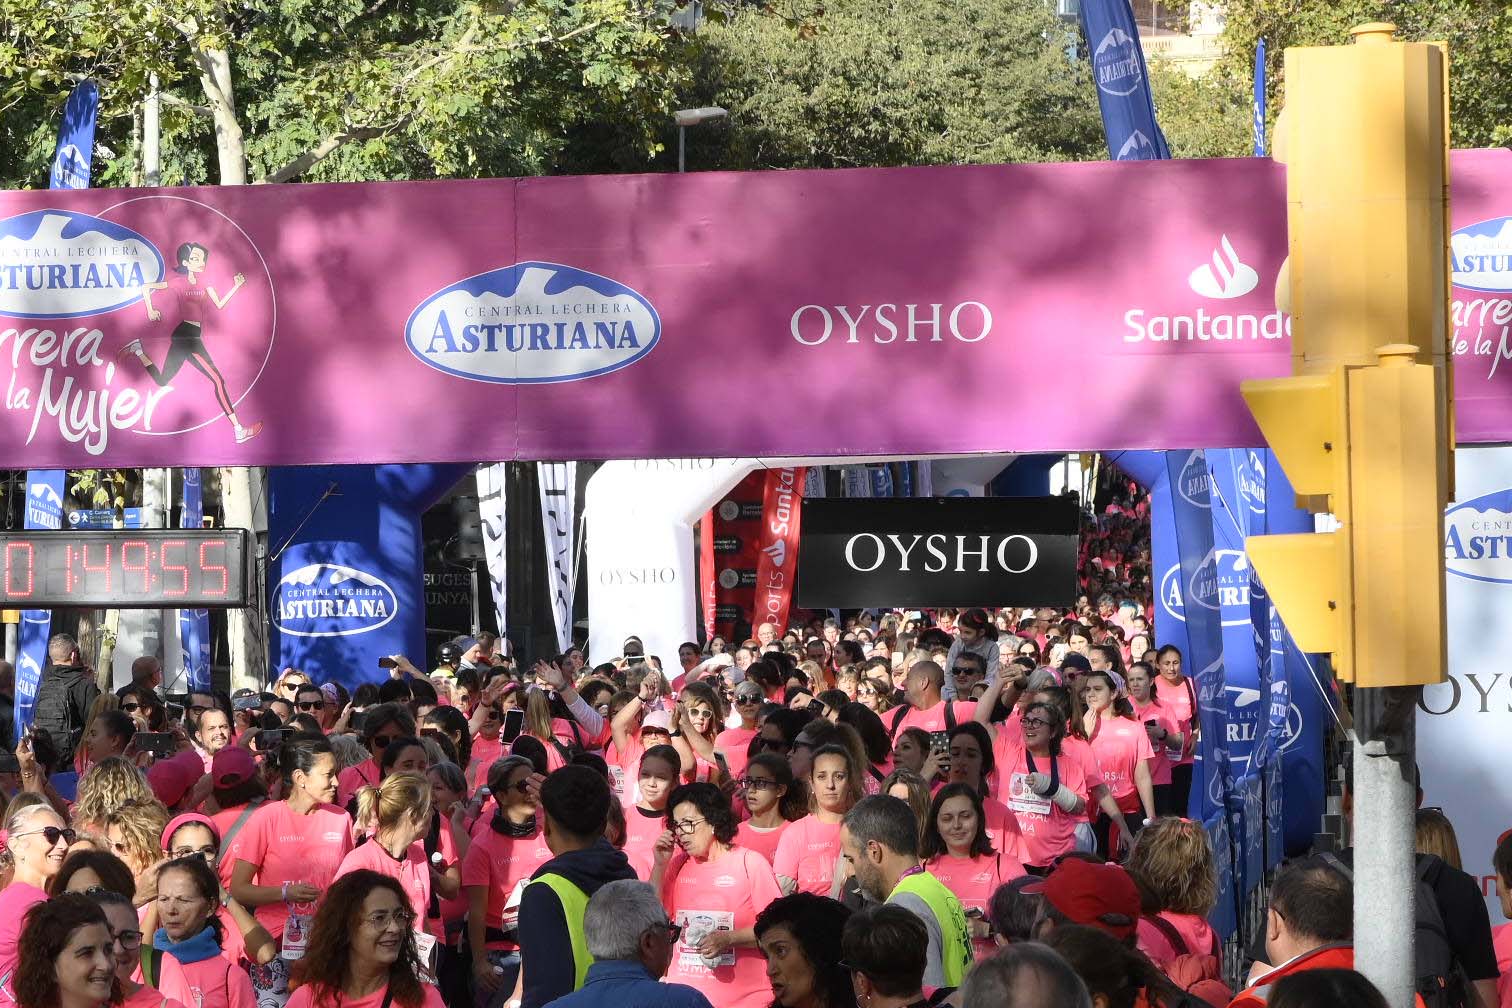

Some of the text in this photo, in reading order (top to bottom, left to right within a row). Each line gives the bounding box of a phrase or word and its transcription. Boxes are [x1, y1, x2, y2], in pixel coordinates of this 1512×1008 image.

[68, 245, 140, 257] LECHERA
[464, 302, 633, 319] CENTRAL LECHERA
[790, 301, 993, 346] OYSHO
[425, 309, 641, 354] ASTURIANA
[1475, 328, 1493, 356] la
[6, 370, 31, 410] la
[25, 361, 175, 456] Mujer
[844, 532, 1040, 575] OYSHO
[600, 567, 675, 585] OYSHO
[288, 587, 383, 598] CENTRAL LECHERA
[767, 571, 784, 627] ports
[276, 593, 388, 621] ASTURIANA
